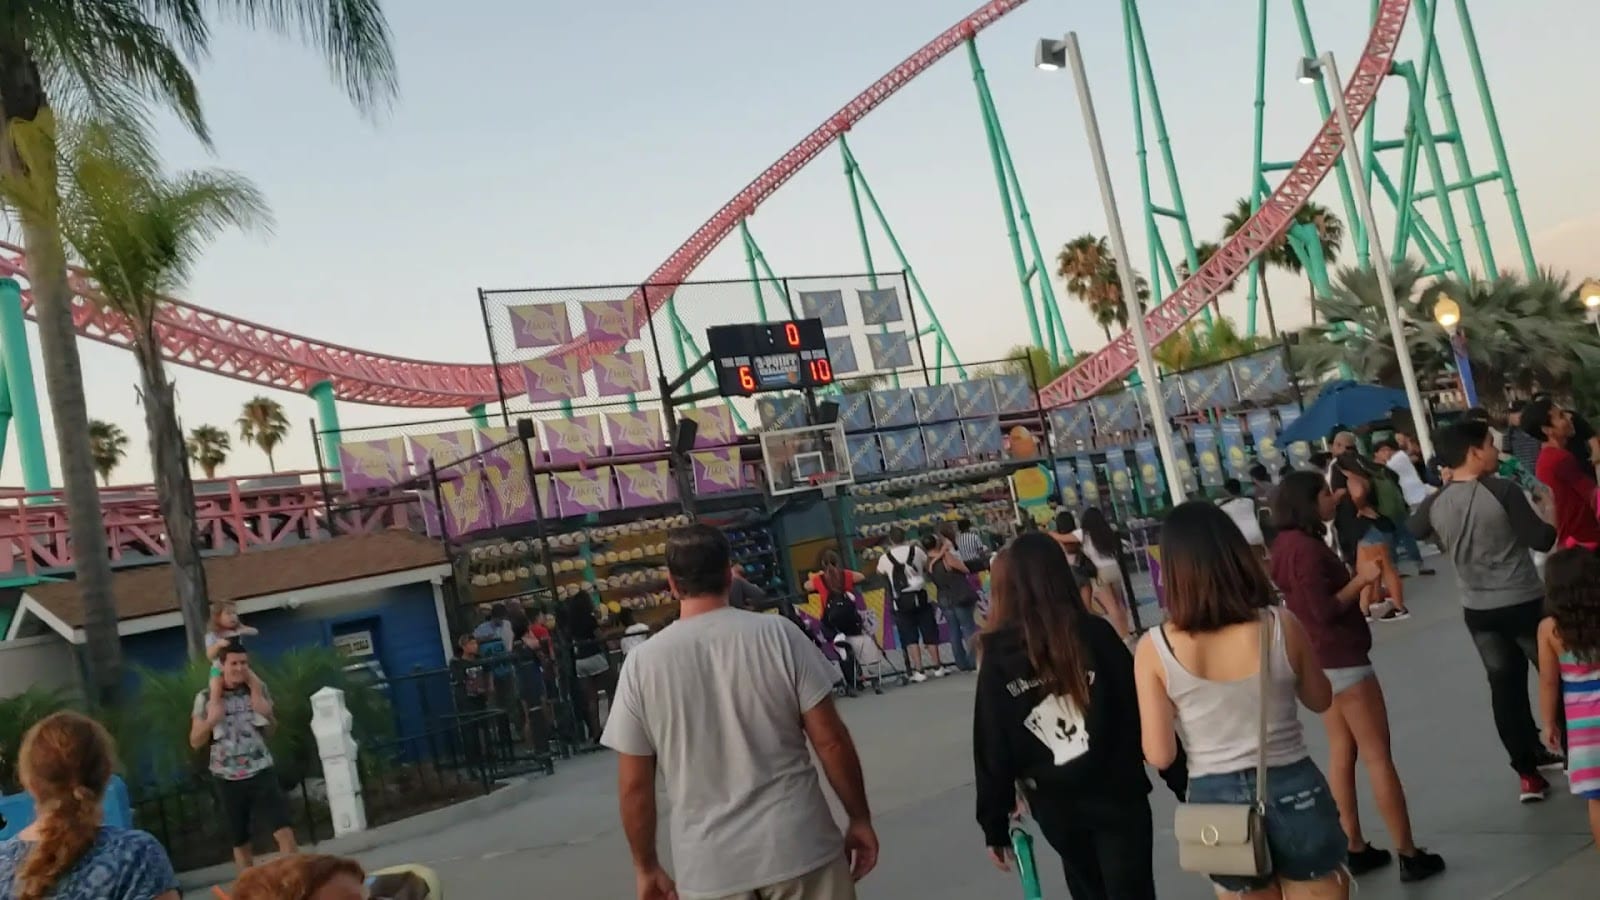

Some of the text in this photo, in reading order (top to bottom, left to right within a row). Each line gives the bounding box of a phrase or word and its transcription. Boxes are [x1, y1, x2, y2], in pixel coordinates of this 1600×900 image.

[784, 322, 799, 345] 0
[739, 366, 754, 390] 6
[809, 358, 831, 381] 10
